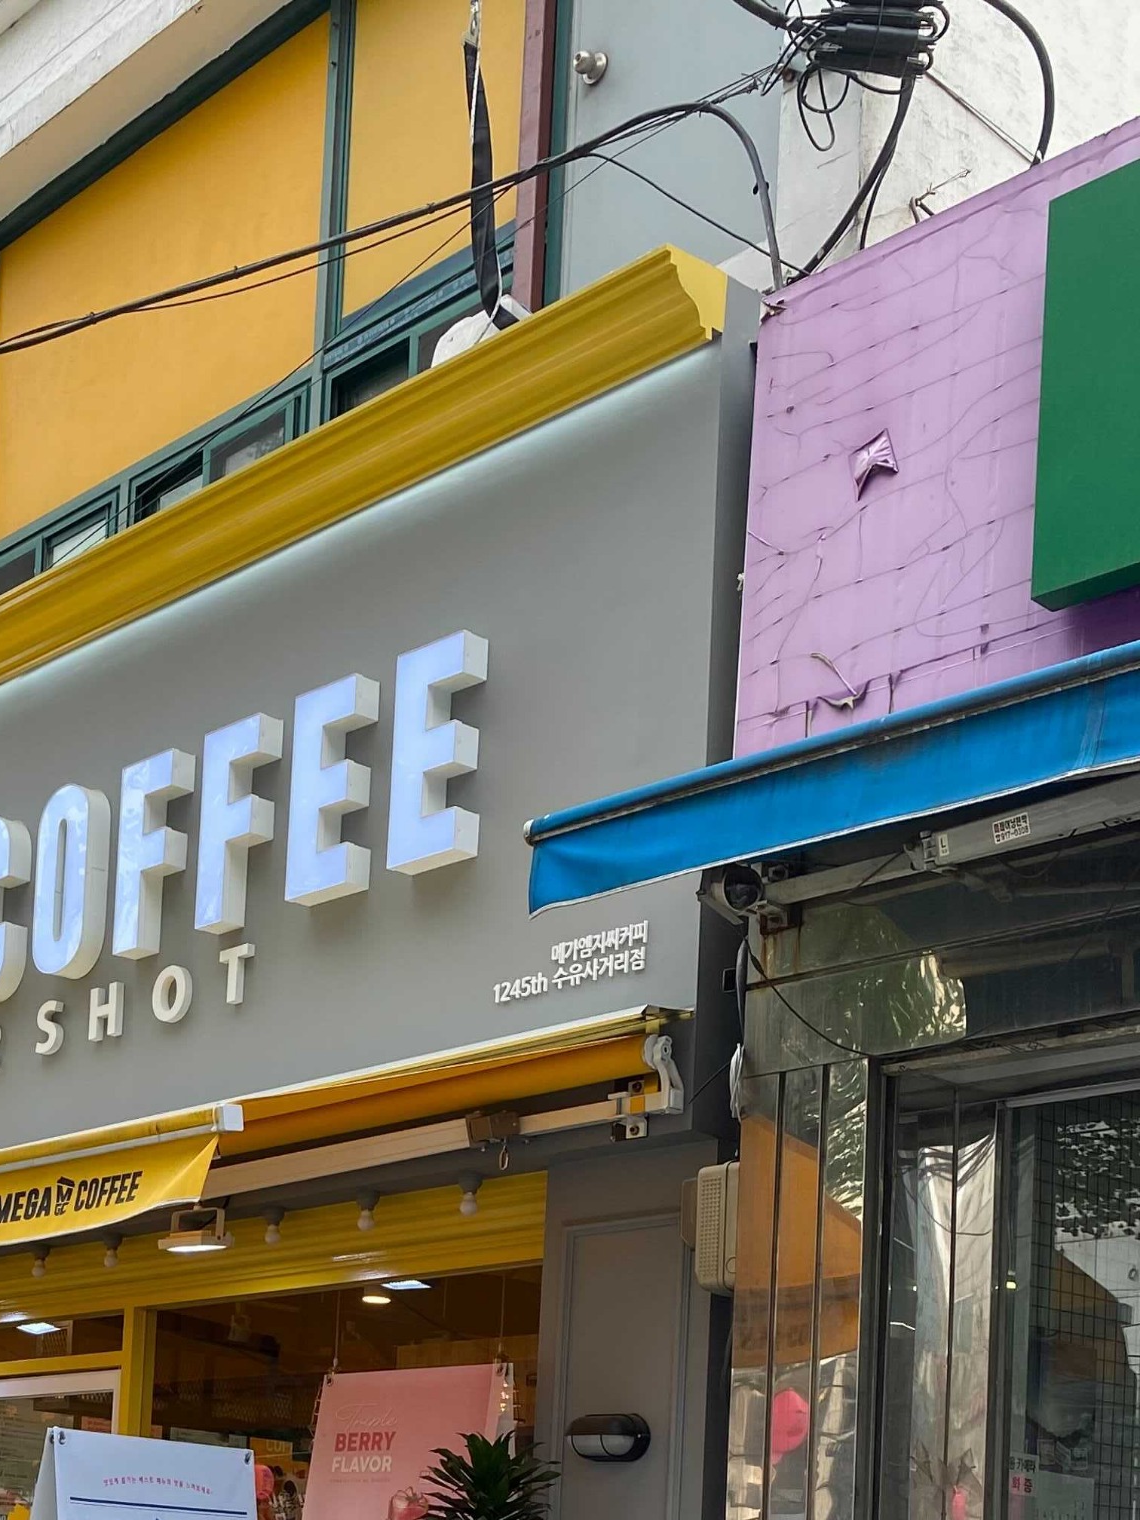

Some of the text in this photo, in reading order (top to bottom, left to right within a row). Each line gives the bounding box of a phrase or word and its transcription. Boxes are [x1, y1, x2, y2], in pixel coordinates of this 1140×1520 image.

[551, 920, 648, 964] 메가엠지씨커피
[493, 947, 645, 1003] 1245th 수유사거리점
[36, 943, 255, 1056] SHOT
[73, 1170, 143, 1212] COFFEE
[334, 1431, 396, 1452] BERRY
[331, 1456, 392, 1473] FLAVOR
